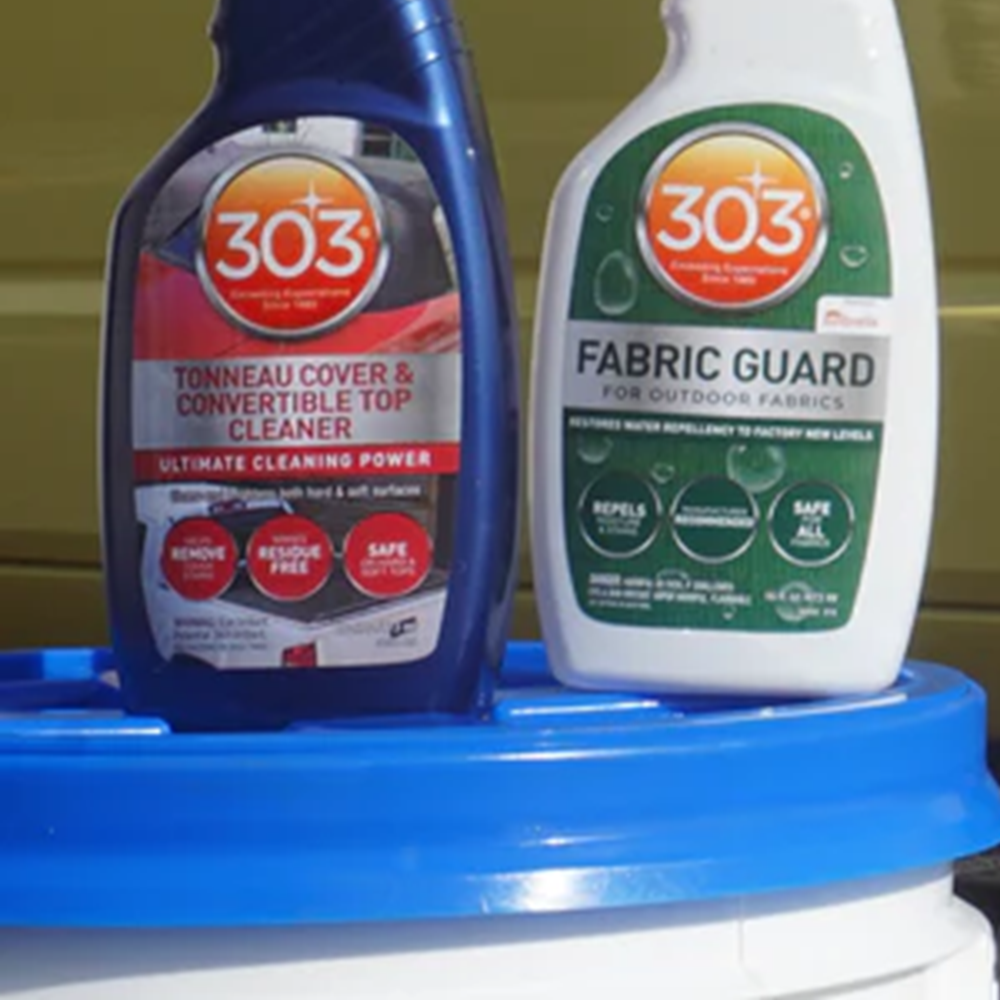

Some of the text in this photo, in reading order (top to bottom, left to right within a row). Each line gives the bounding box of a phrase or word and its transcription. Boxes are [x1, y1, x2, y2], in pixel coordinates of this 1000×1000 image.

[657, 184, 804, 257] 303
[215, 209, 365, 281] 303
[173, 361, 414, 390] TONNEAU COVER &
[576, 339, 876, 388] FABRIC GUARD
[175, 388, 413, 417] CONVERTIBLE TOP
[602, 384, 846, 411] FOR OUTDOOR FABRICS
[228, 416, 353, 442] CLEANER
[569, 415, 875, 443] RESTORES WATER REPELLENCY TO FACTORY NEW LEVELS
[159, 449, 432, 473] ULTIMATE CLEANING POWER
[336, 484, 345, 498] &
[372, 483, 421, 497] surfaces
[592, 501, 647, 518] REPELS
[793, 500, 832, 517] SAFE
[797, 524, 825, 540] ALL
[171, 546, 226, 561] REMOVE
[258, 545, 321, 561] RESIDUE
[367, 541, 409, 558] SAFE
[269, 560, 310, 576] FREE
